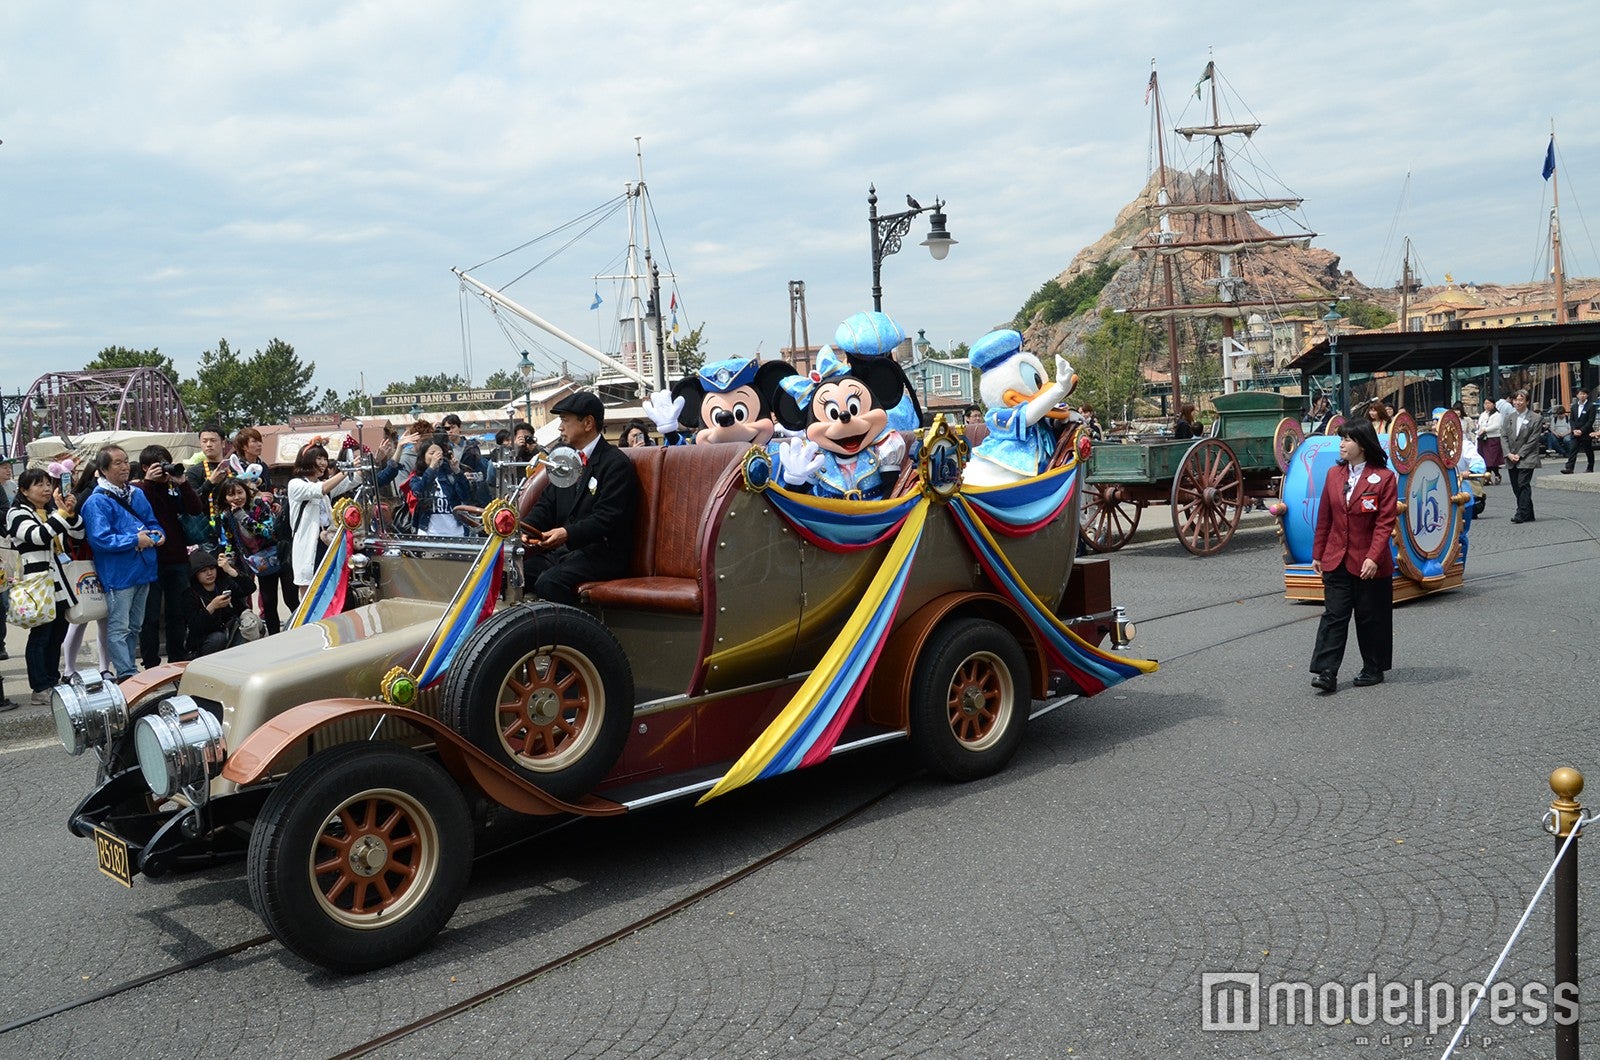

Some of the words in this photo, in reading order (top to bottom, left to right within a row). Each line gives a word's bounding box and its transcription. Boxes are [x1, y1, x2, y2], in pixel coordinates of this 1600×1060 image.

[385, 395, 417, 405] GRAND
[420, 394, 451, 403] BANKS
[456, 392, 496, 401] CANNERY
[1412, 472, 1440, 536] 15
[98, 837, 127, 878] R5182
